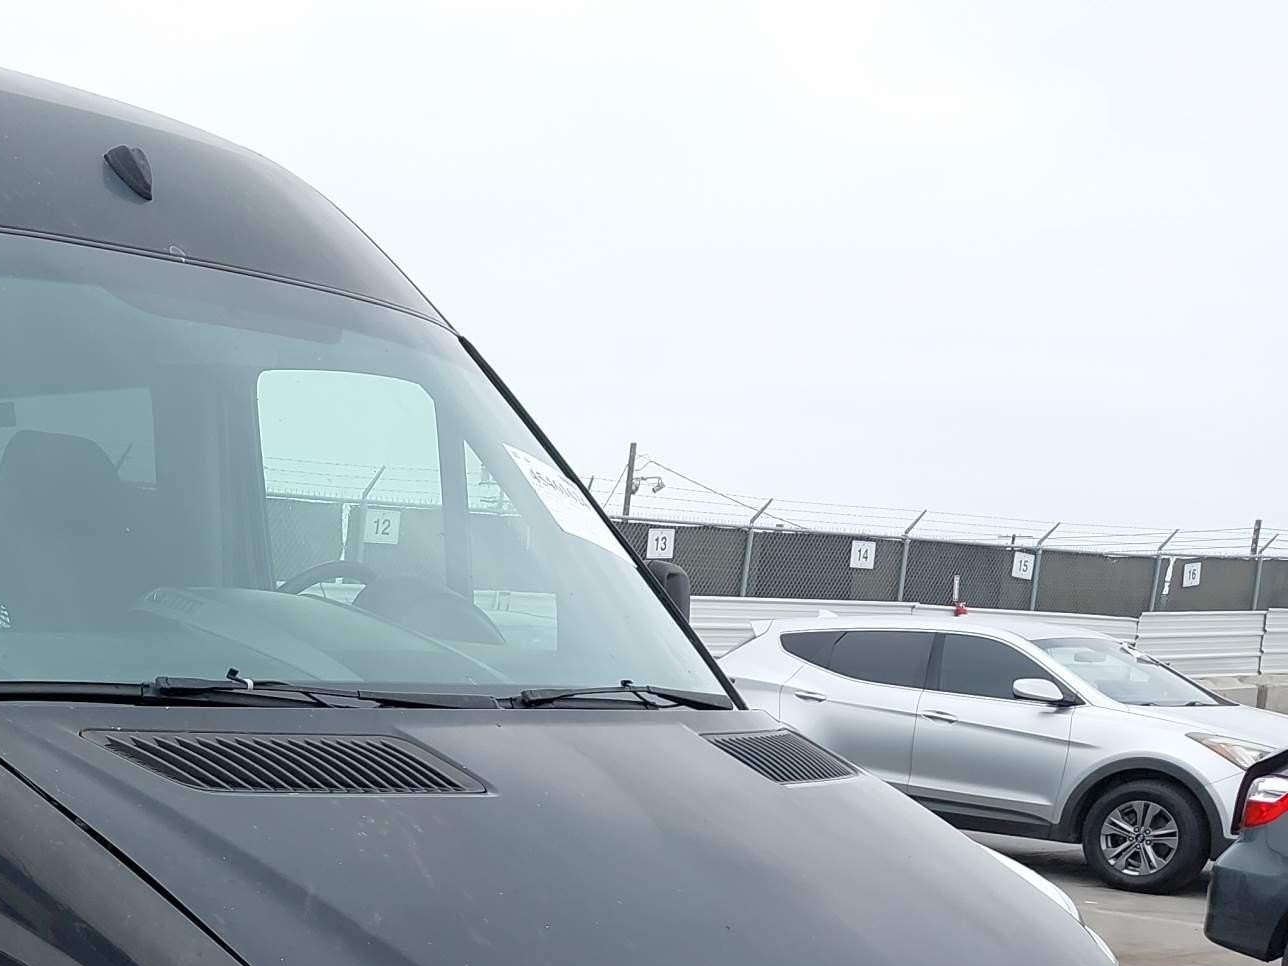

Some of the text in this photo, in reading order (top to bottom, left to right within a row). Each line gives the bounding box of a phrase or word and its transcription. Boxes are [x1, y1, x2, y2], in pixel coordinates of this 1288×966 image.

[372, 518, 392, 536] 12
[654, 535, 668, 552] 13
[857, 547, 869, 561] 14
[1018, 559, 1029, 573] 15
[1188, 568, 1197, 581] 16
